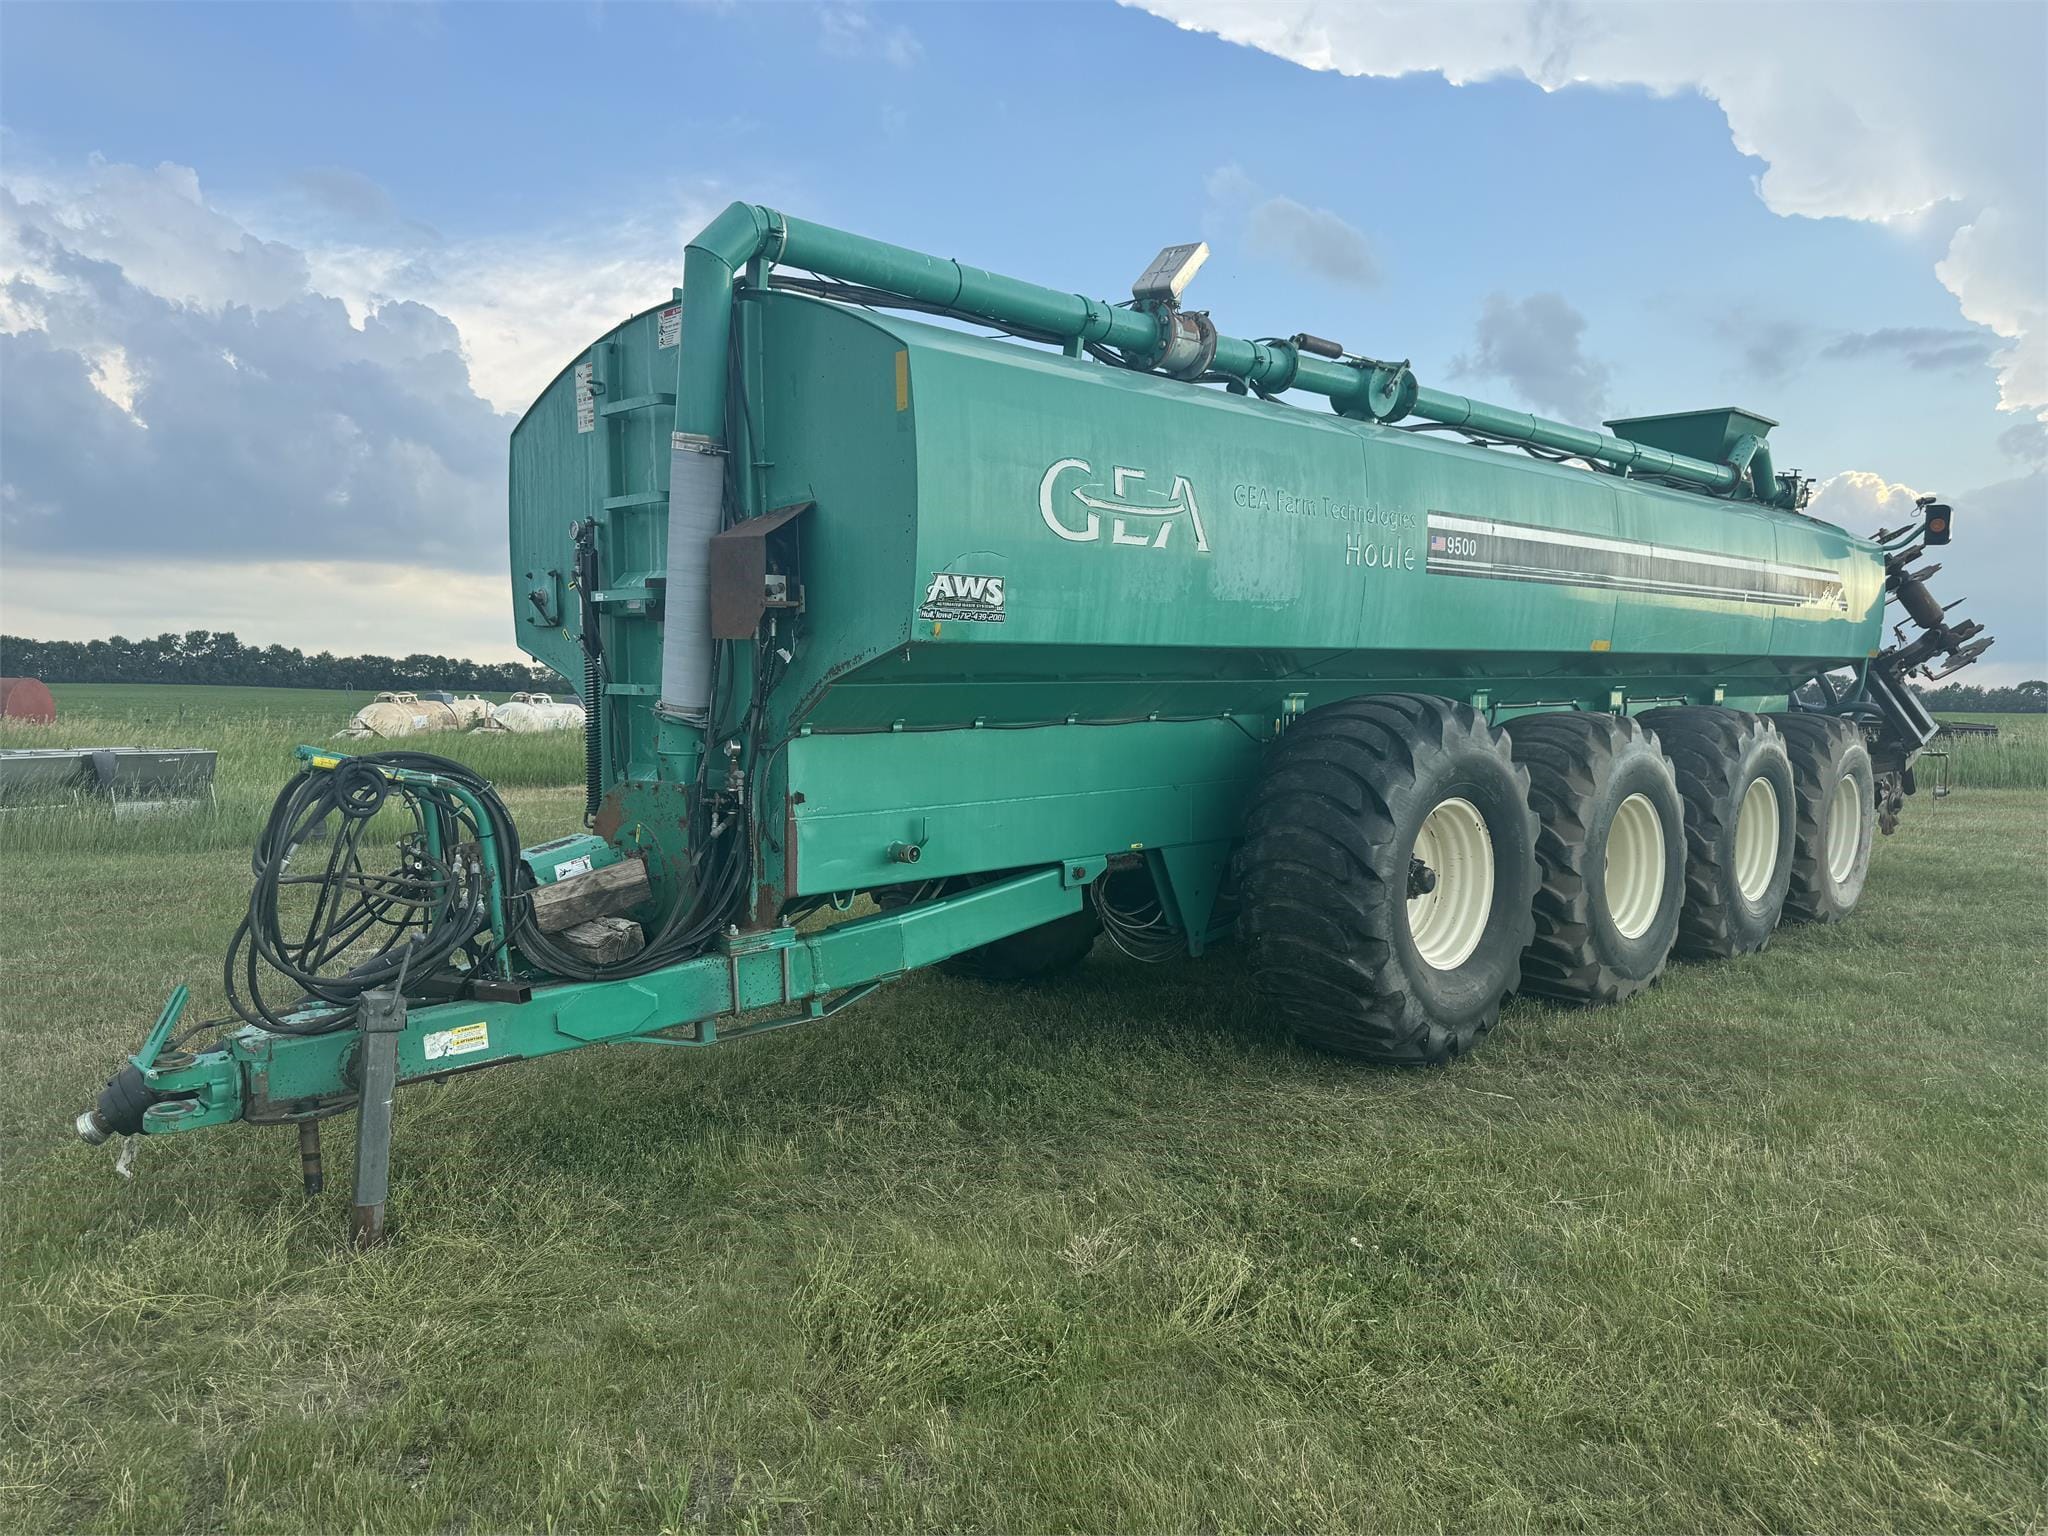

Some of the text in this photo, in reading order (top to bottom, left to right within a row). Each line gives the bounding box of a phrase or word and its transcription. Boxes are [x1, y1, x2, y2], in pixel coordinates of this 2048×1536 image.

[1039, 457, 1211, 552] GEA
[1234, 484, 1416, 532] GEA Farm Technologies
[1345, 532, 1416, 570] Houle
[1447, 536, 1477, 557] 9500
[927, 575, 1003, 606] AWS
